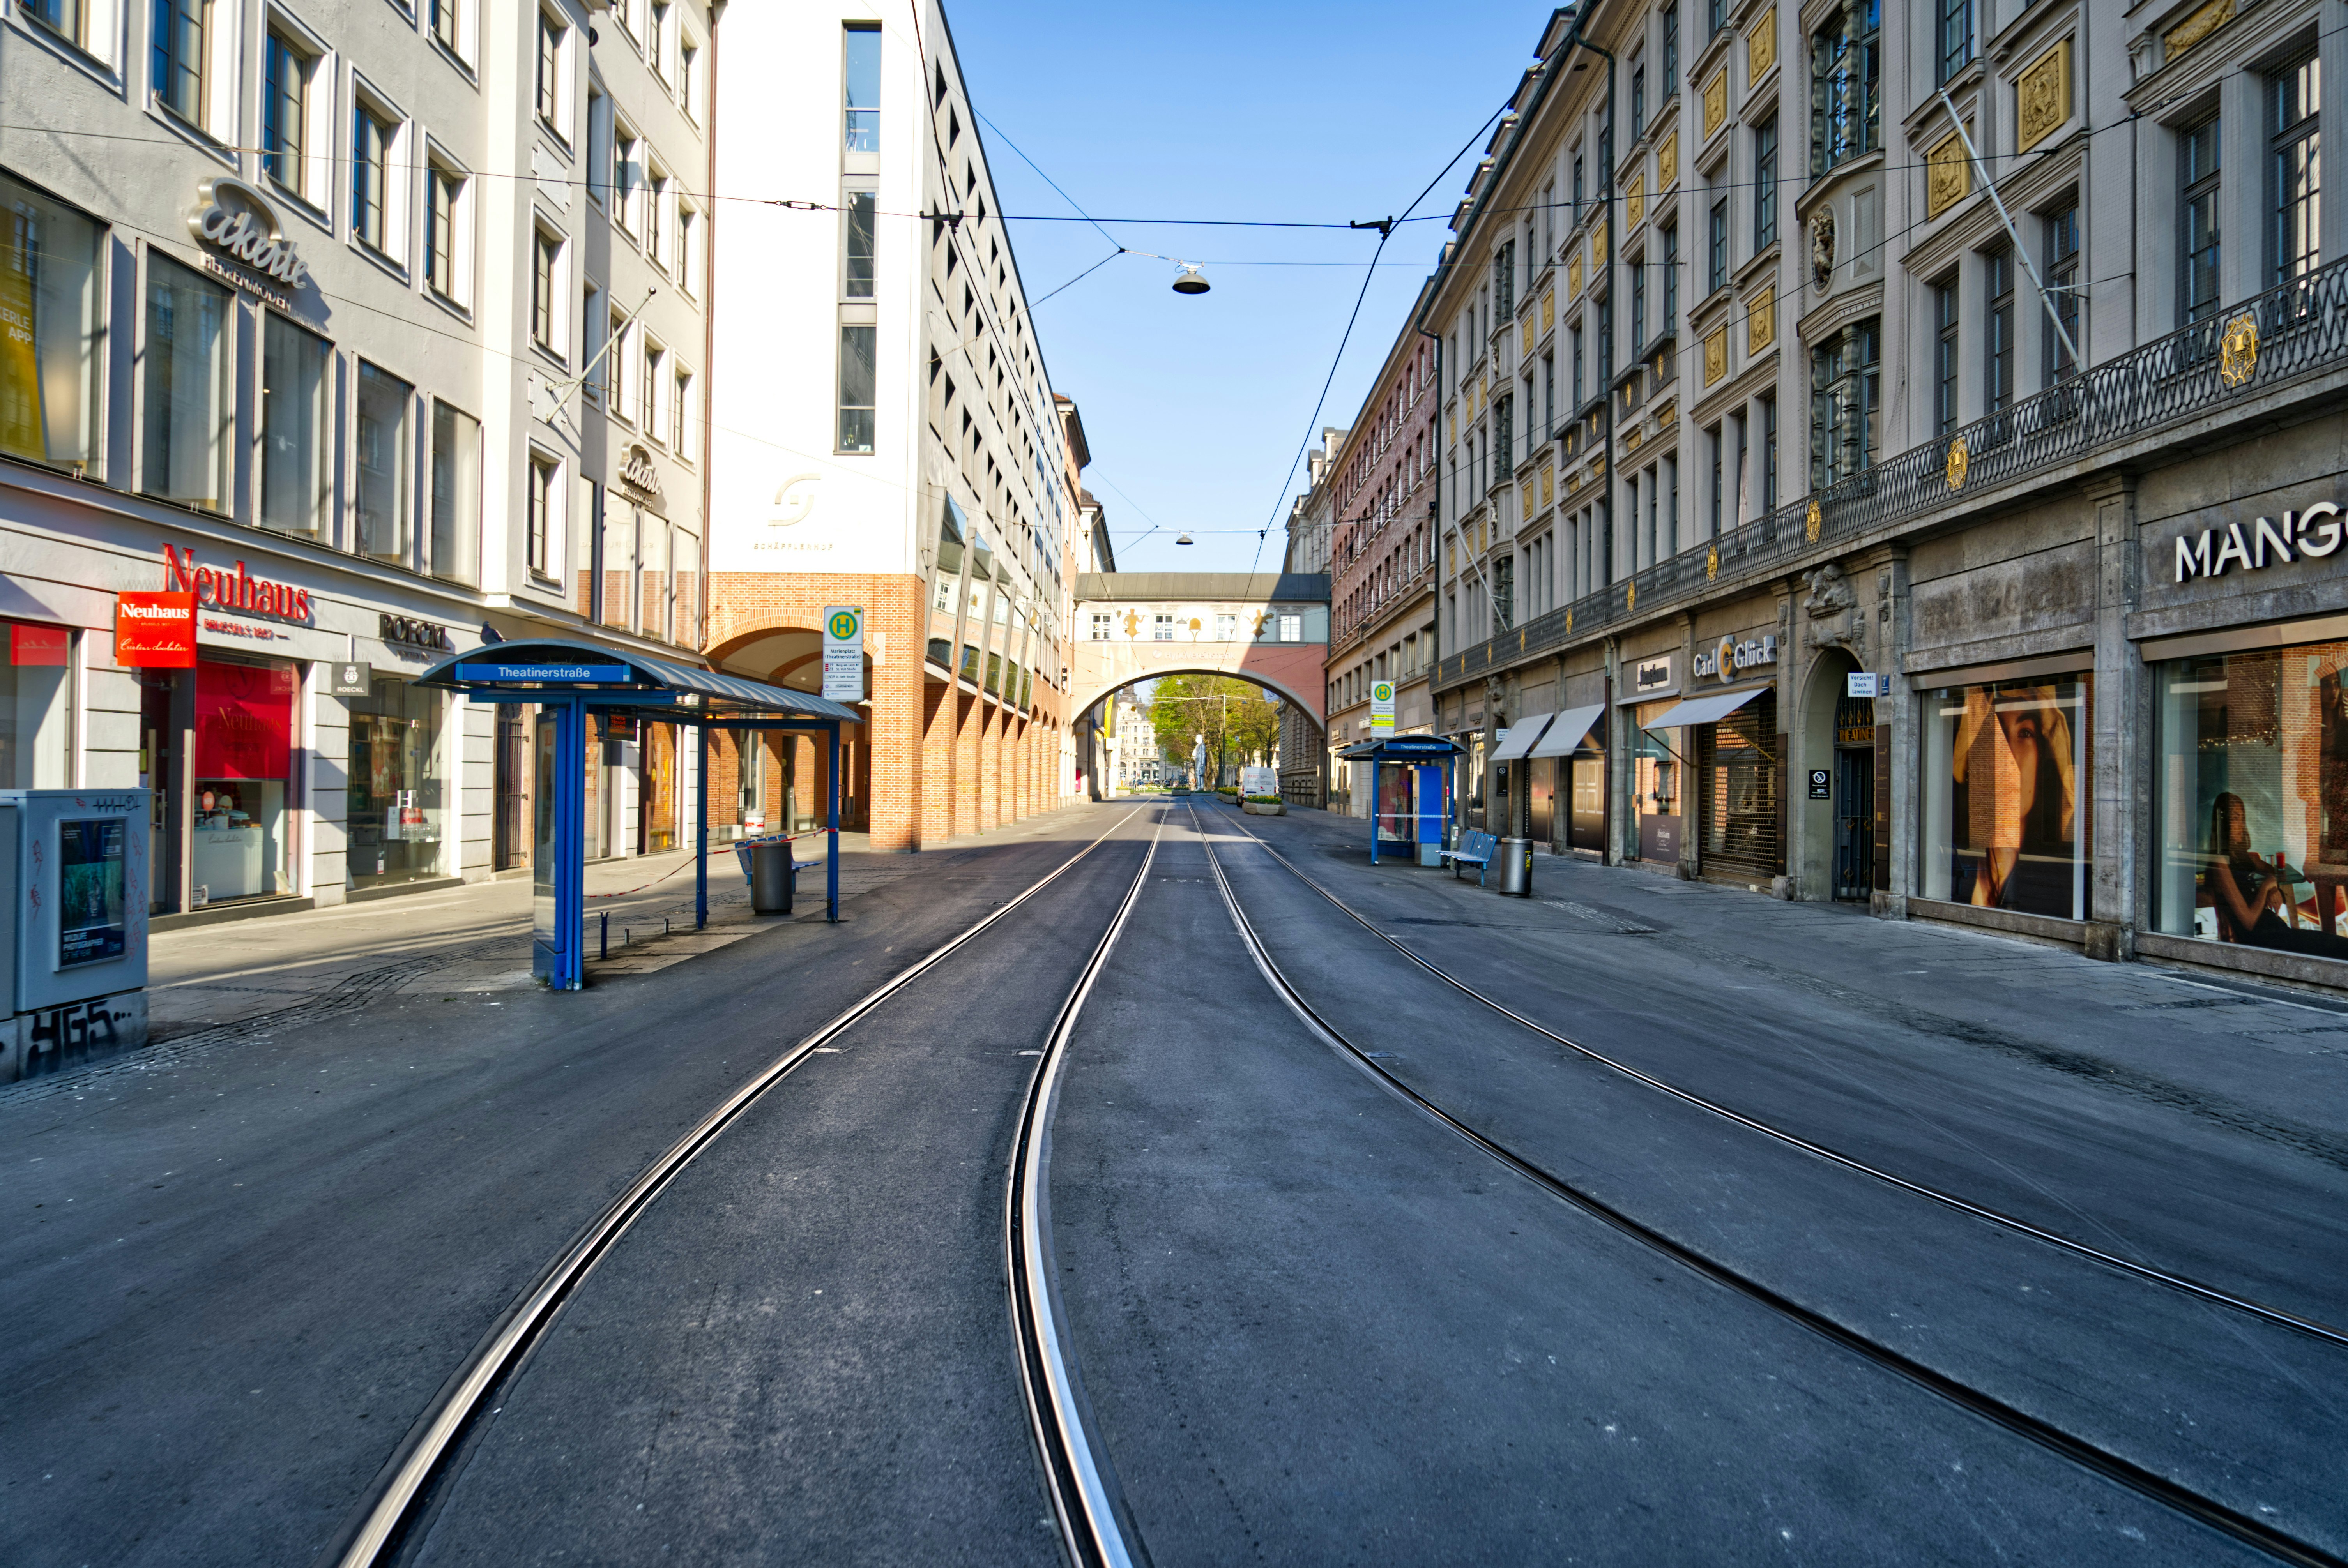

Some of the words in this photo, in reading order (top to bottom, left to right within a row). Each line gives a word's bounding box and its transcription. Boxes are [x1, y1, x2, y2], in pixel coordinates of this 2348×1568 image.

[198, 177, 308, 289] Eckerle
[200, 251, 291, 311] HERRENMODEN
[9, 327, 31, 344] APP
[624, 441, 661, 494] Eckerle
[622, 484, 653, 508] HERRENMODEN
[2176, 501, 2348, 582] MANG
[162, 543, 308, 620] Neuhaus
[121, 604, 189, 618] Neuhaus
[204, 618, 250, 636] BRUSSELS
[253, 627, 272, 639] 1857
[380, 614, 451, 650] ROECKL
[836, 618, 849, 633] H
[1165, 652, 1235, 661] HypoVereinsbank
[1694, 648, 1718, 677] Carl
[1735, 635, 1775, 669] Glück
[499, 667, 590, 678] Theatinerstraße
[1883, 677, 1886, 686] 7
[1379, 688, 1387, 697] H
[218, 707, 281, 731] Neuhaus
[1838, 727, 1875, 742] THEATINER
[63, 938, 104, 951] PHOTOGRAPHER
[64, 932, 87, 943] WILDLIFE
